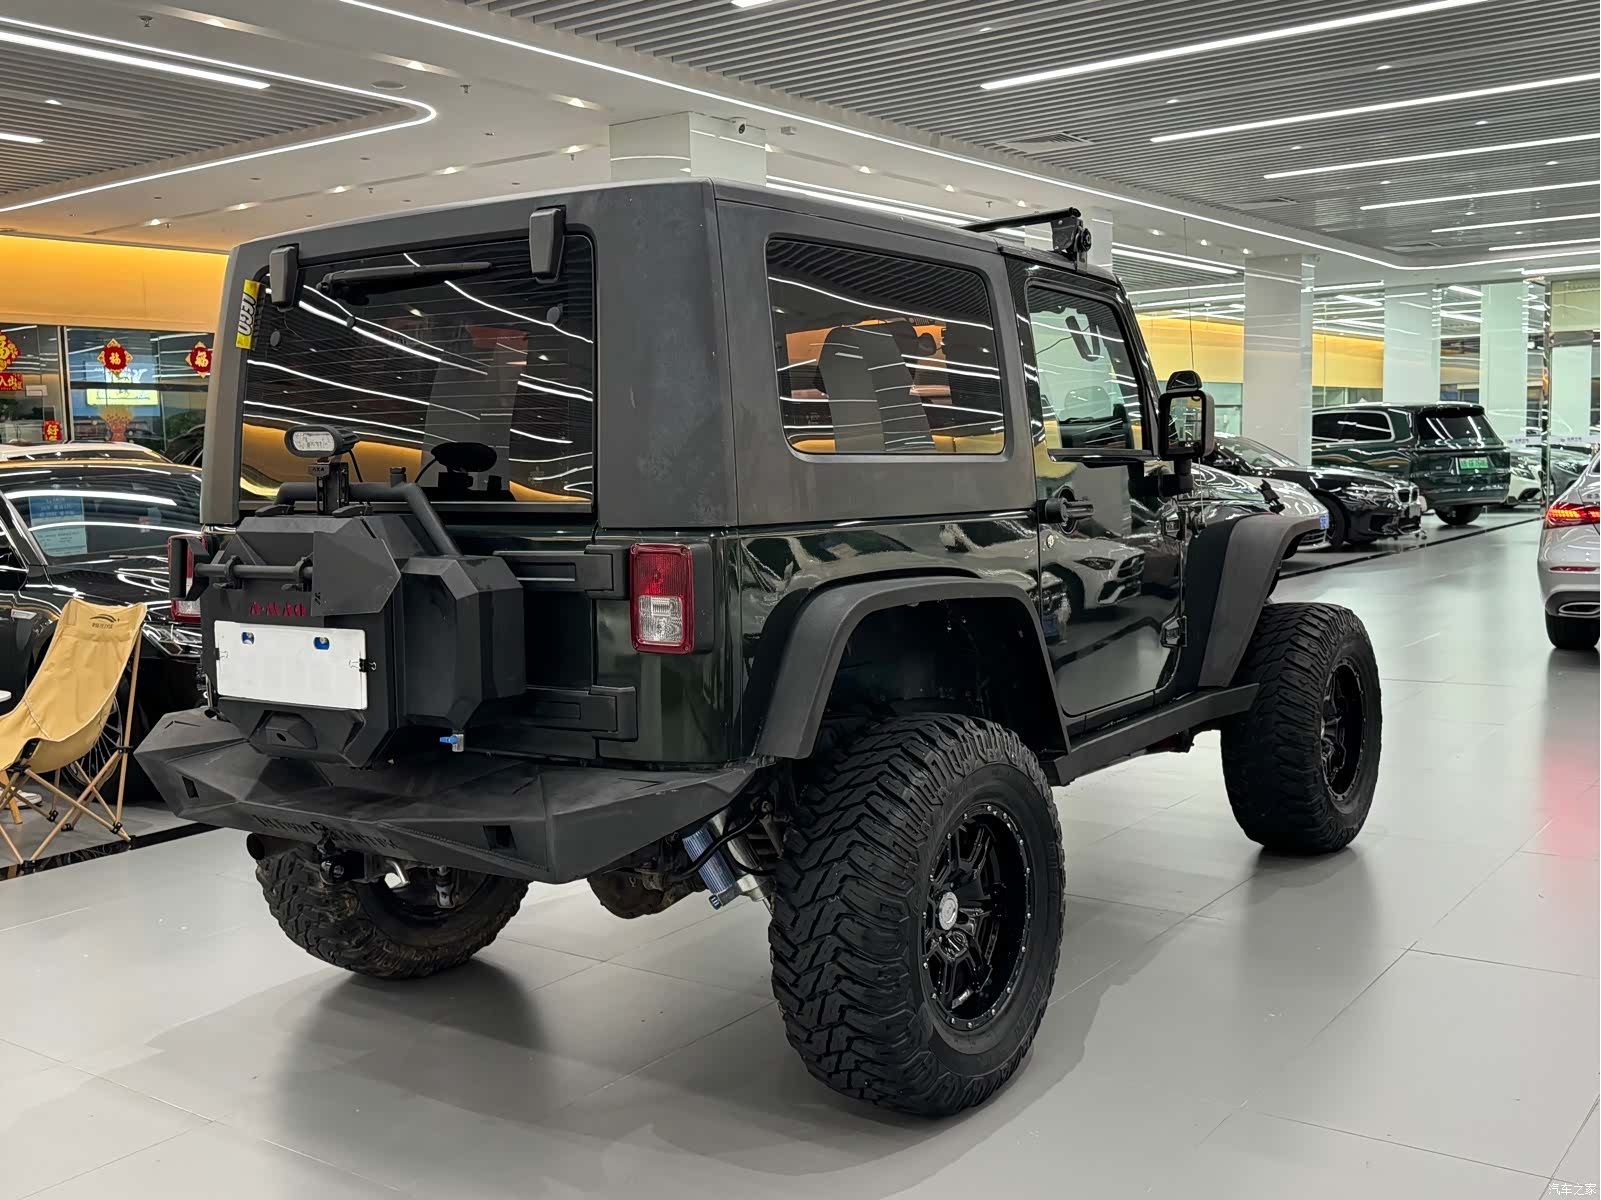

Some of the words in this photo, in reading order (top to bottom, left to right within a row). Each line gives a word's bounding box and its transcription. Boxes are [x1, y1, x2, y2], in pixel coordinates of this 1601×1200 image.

[238, 292, 256, 337] LEGO
[109, 352, 121, 365] 福
[194, 350, 209, 367] 福
